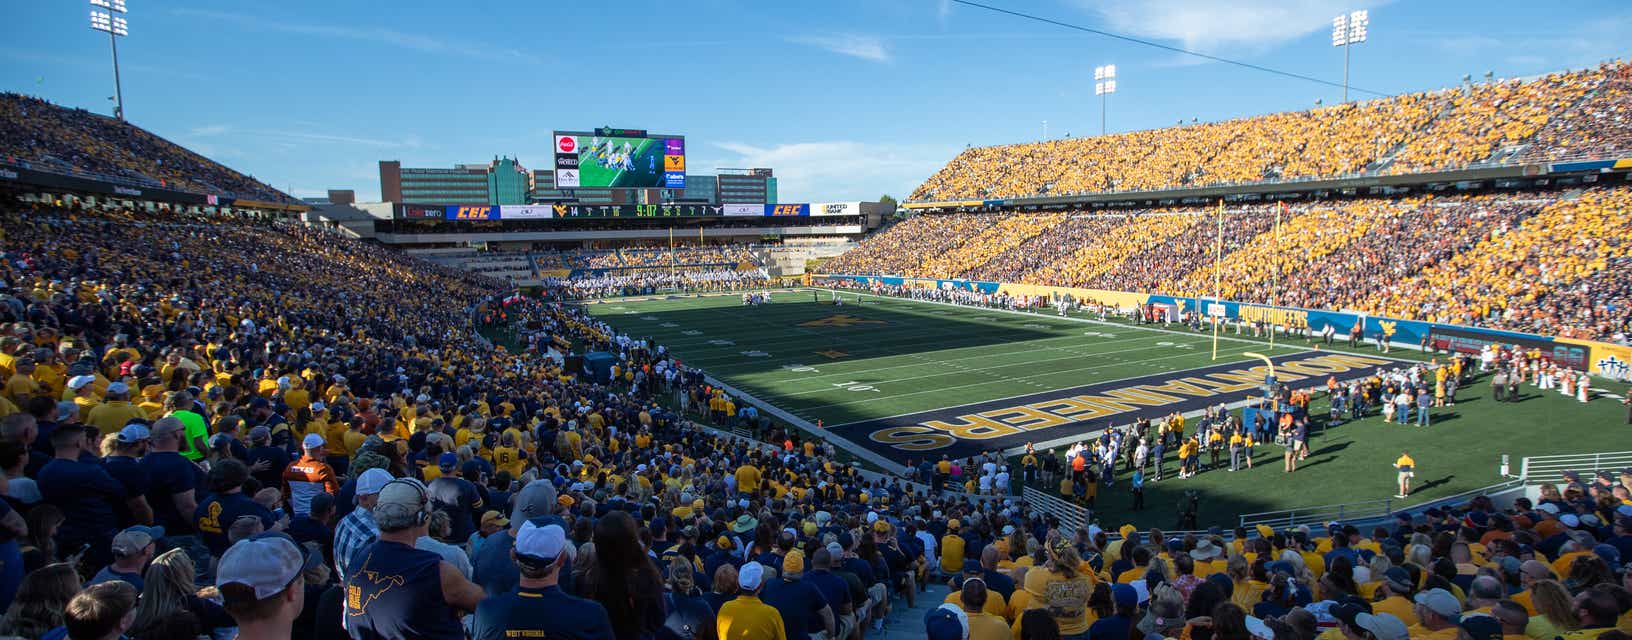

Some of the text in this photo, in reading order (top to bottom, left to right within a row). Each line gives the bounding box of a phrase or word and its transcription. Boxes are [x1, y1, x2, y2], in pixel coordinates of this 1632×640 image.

[571, 206, 578, 217] 14
[637, 204, 657, 217] 9:07
[832, 380, 876, 392] 10
[868, 354, 1392, 452] MOUNTAINEERS
[500, 452, 510, 464] 16
[291, 465, 314, 474] TEXAS
